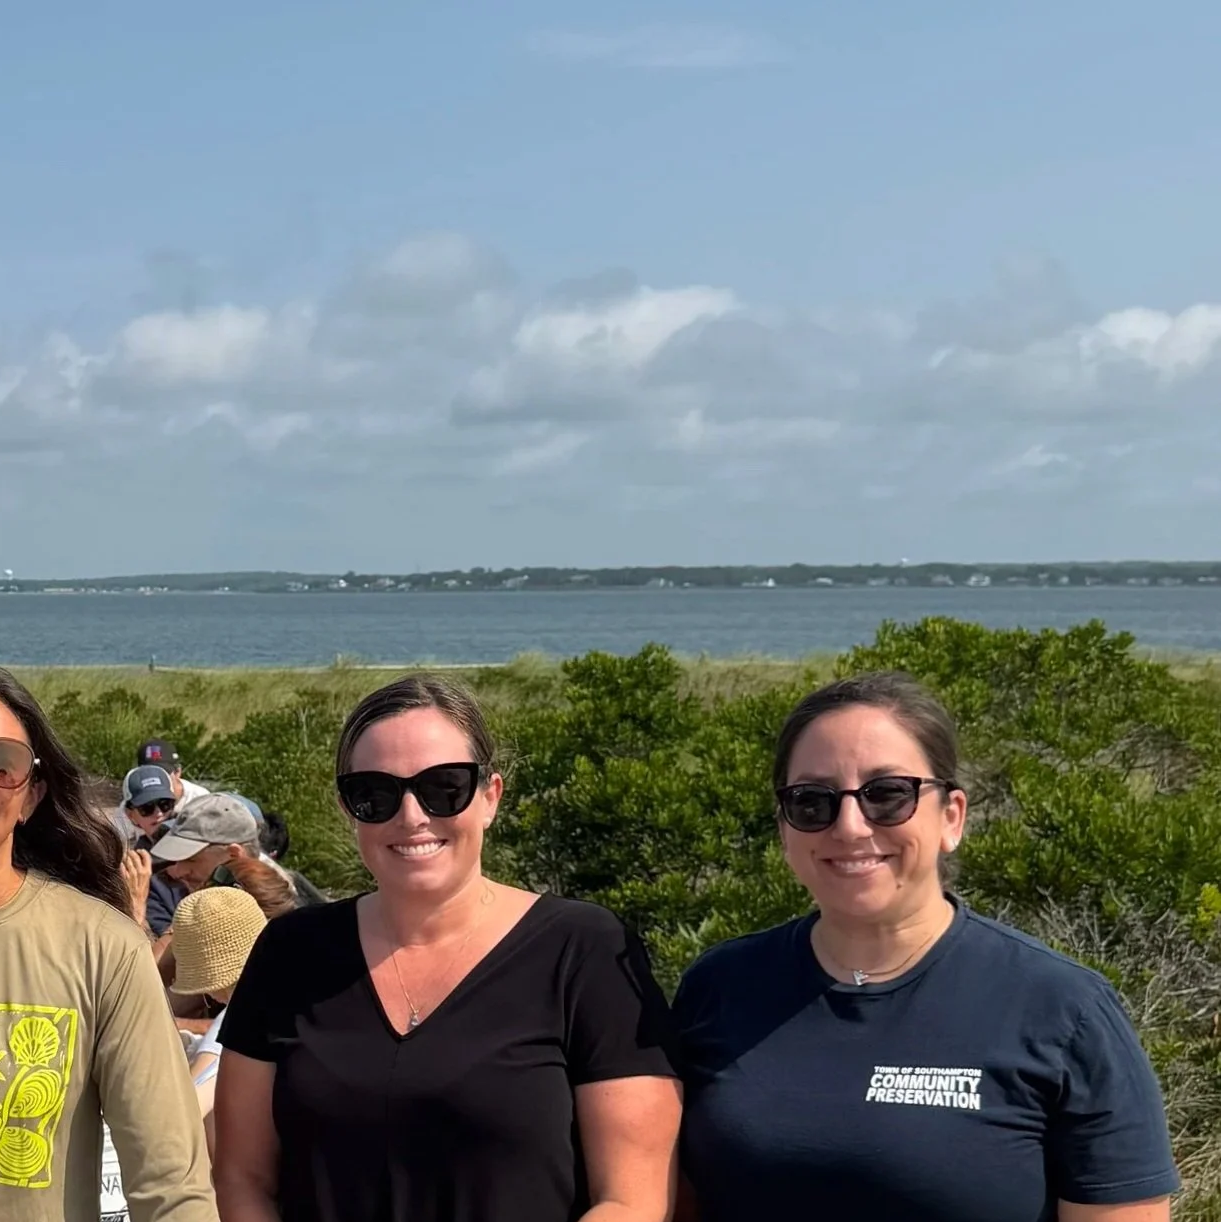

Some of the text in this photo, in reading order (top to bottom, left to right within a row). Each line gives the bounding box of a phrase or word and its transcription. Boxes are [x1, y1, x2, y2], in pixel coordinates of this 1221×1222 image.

[915, 1067, 982, 1077] SOUTHAMPTON
[870, 1074, 981, 1093] COMMUNITY
[866, 1088, 981, 1110] PRESERVATION
